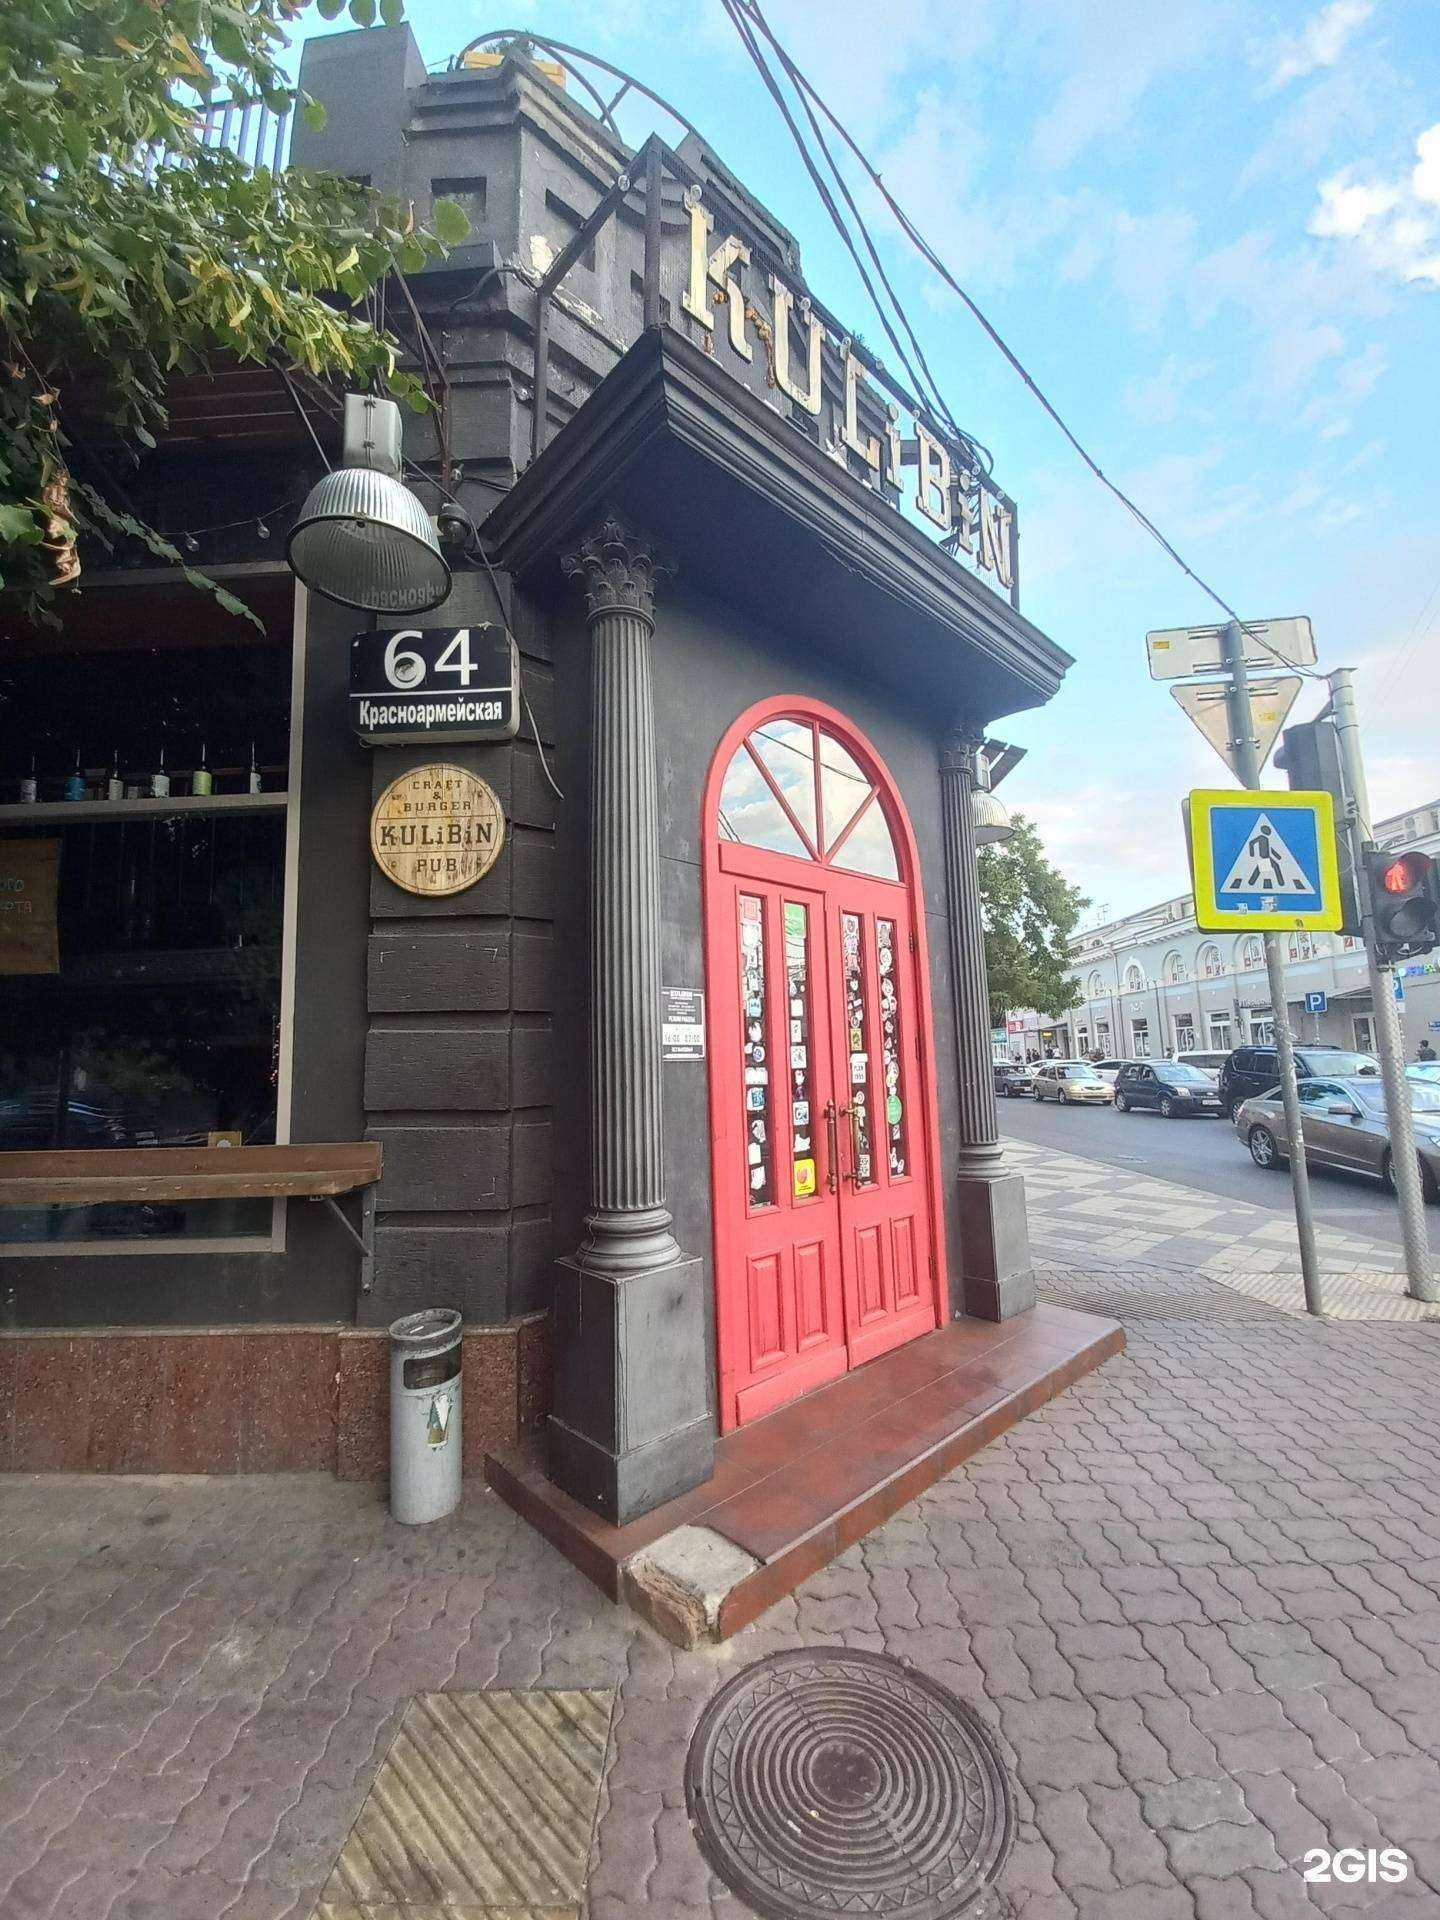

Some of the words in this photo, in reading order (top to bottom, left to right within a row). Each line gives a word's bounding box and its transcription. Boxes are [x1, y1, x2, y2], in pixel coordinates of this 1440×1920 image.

[384, 629, 479, 689] 64
[359, 697, 503, 731] Красноармейская
[412, 780, 463, 790] CRAFT
[432, 791, 442, 800] &
[403, 801, 472, 812] BURGER
[416, 858, 458, 872] PUB
[1309, 994, 1322, 1011] P
